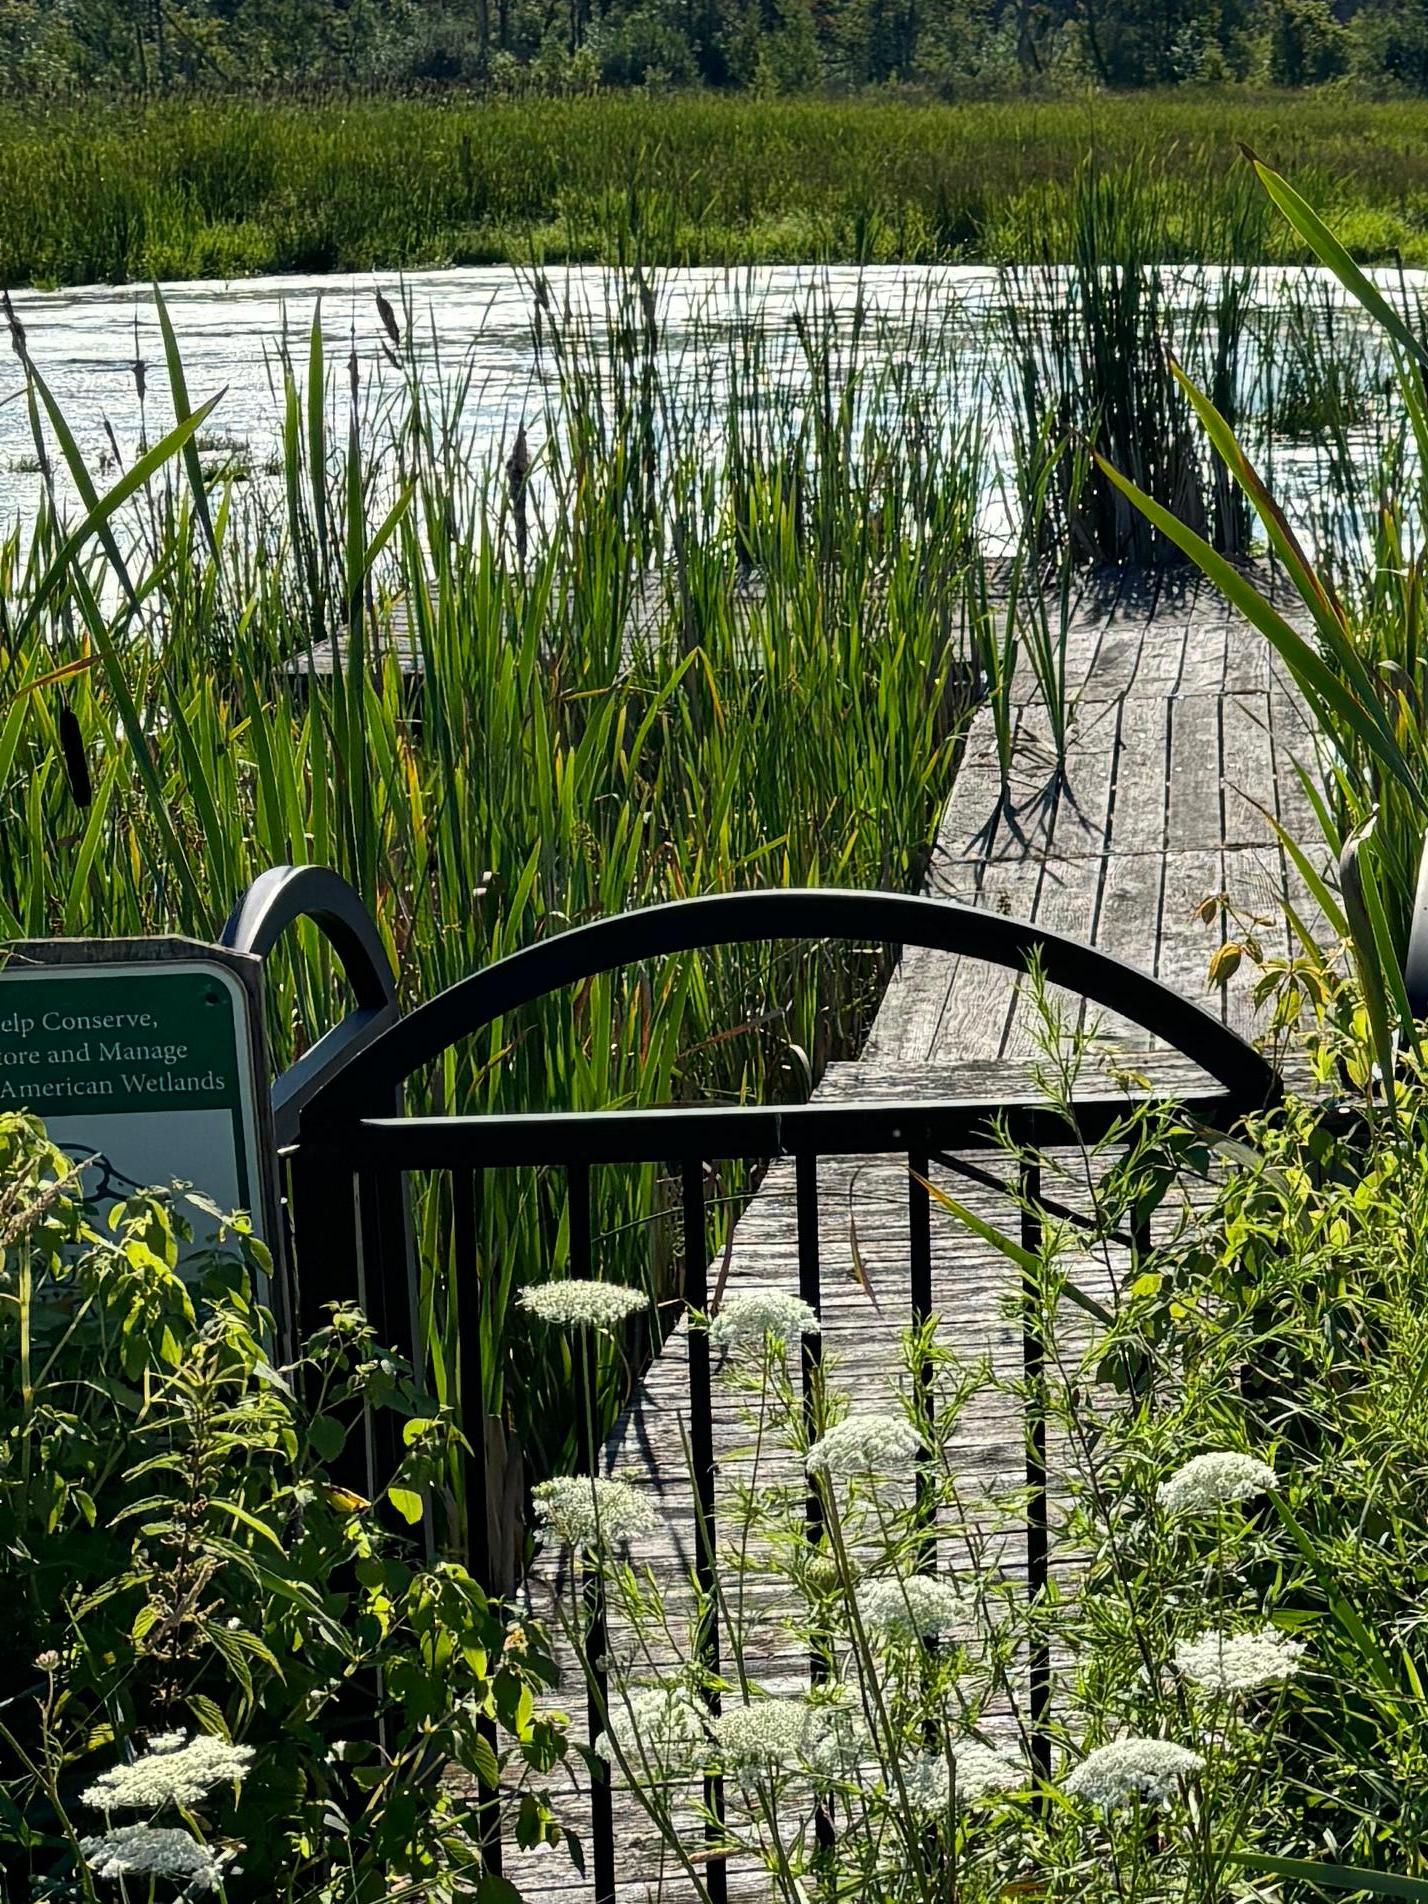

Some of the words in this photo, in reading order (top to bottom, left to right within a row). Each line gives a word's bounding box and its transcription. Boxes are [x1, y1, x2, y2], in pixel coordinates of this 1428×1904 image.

[0, 1012, 35, 1038] elp
[42, 1011, 158, 1032] Conserve,
[0, 1051, 40, 1066] ore
[47, 1042, 91, 1064] and
[99, 1041, 189, 1066] Manage
[0, 1076, 113, 1099] American
[120, 1070, 226, 1094] Wetlands
